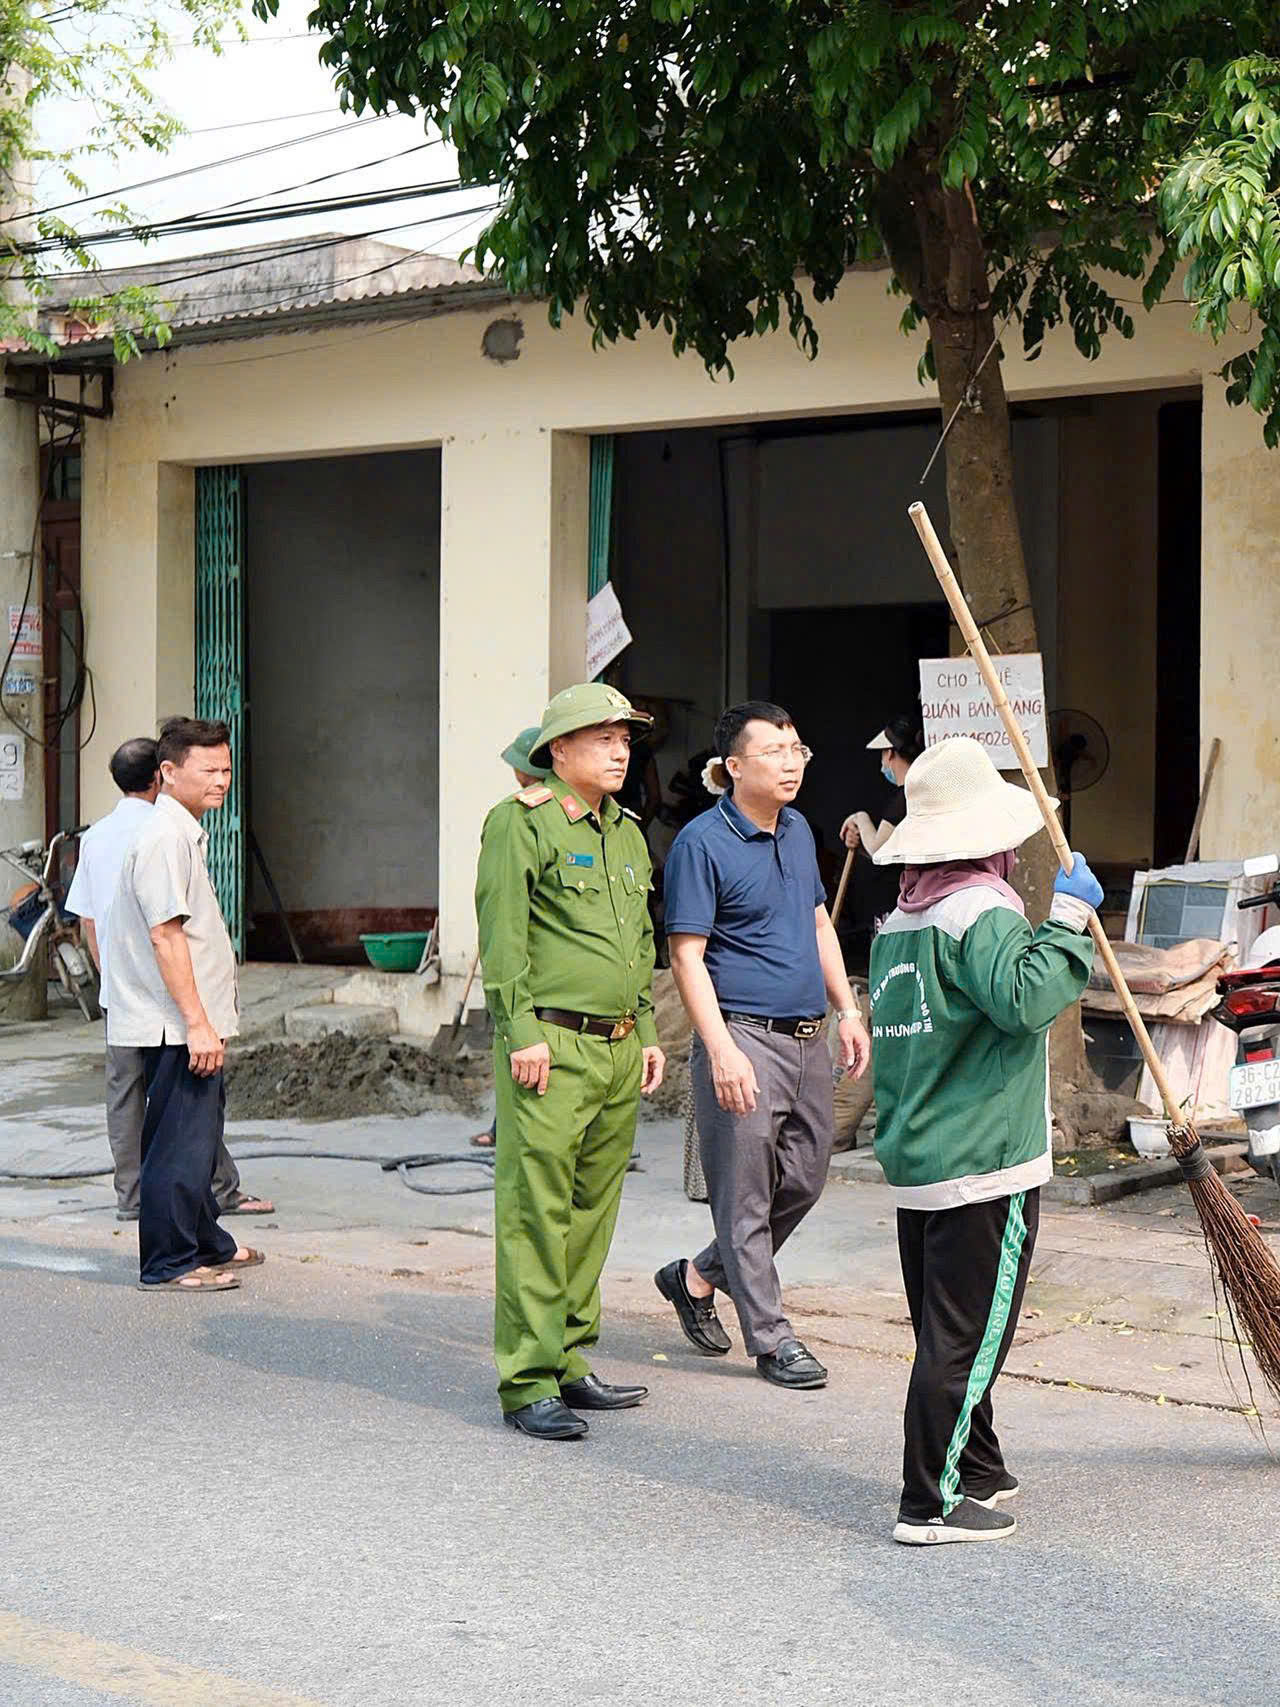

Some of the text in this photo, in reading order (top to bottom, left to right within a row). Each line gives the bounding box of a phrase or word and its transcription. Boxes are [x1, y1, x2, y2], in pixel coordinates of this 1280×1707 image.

[937, 673, 968, 688] CHO
[922, 695, 1042, 719] QUÁN BÁN ÀNG
[1239, 1061, 1280, 1085] 36-C2
